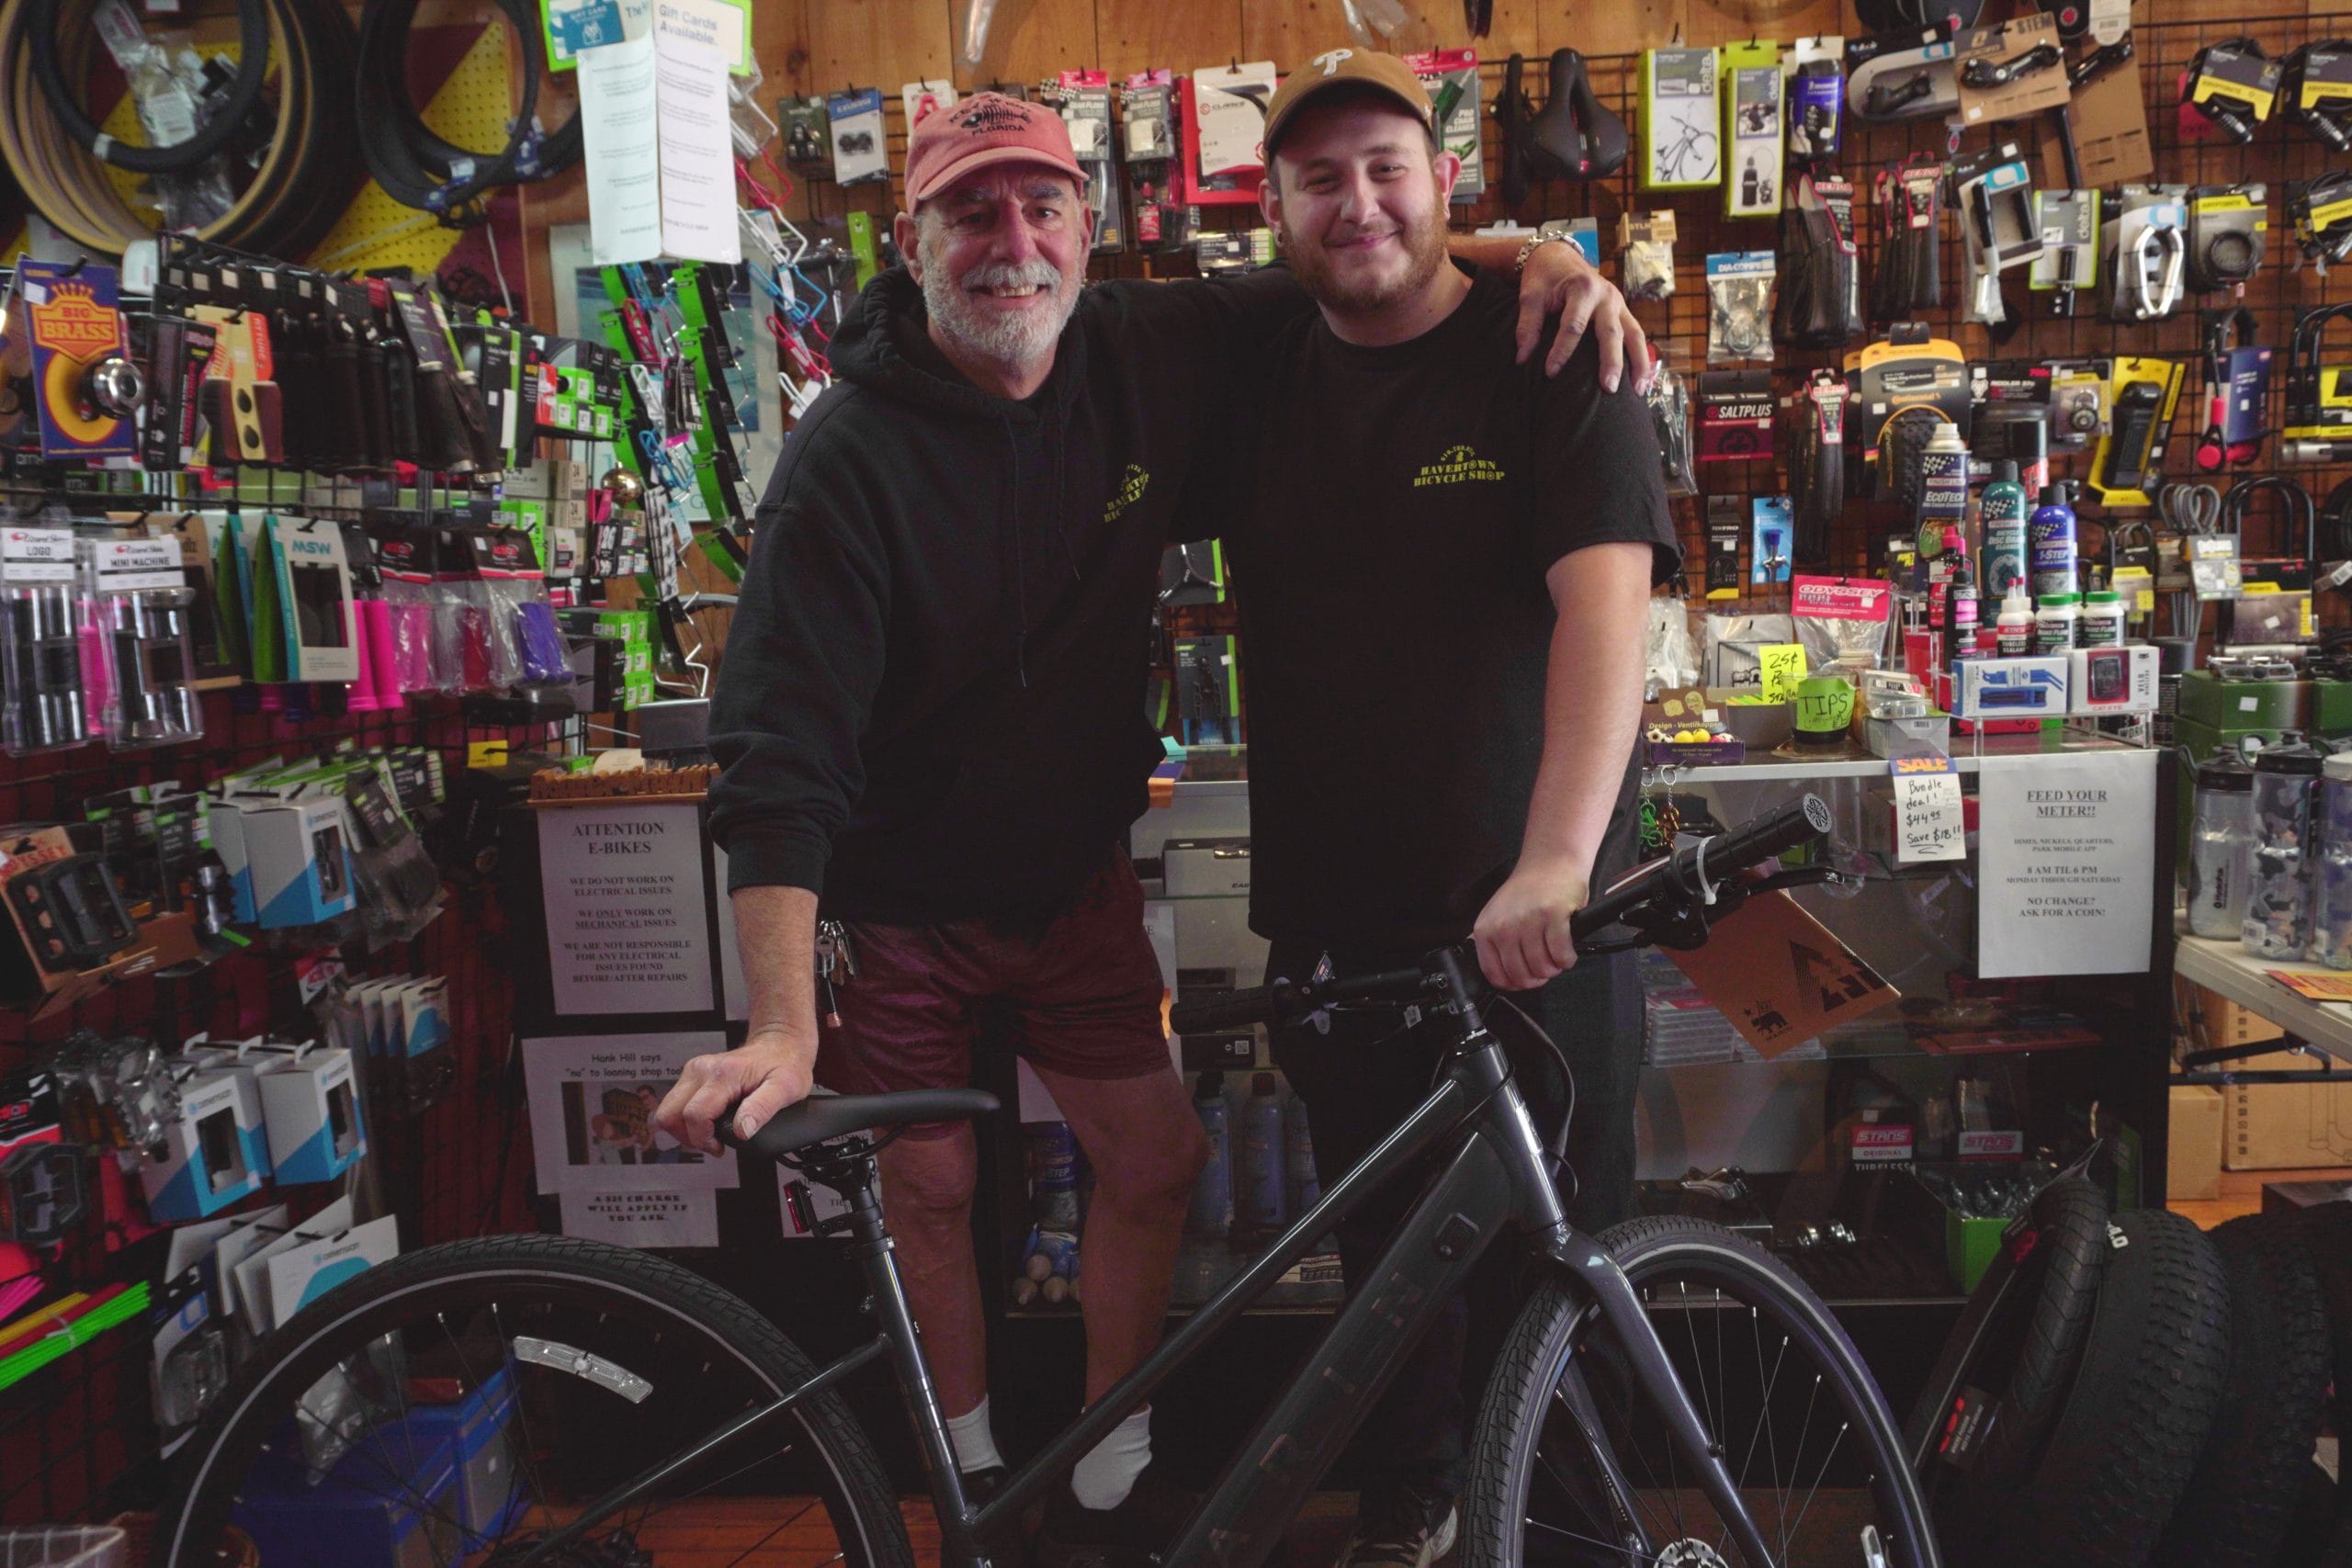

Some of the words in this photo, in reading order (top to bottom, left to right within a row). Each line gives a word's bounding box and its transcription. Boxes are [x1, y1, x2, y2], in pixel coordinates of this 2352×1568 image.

[659, 4, 677, 19] Gift
[682, 12, 718, 30] Cards
[2017, 12, 2053, 35] STEM
[1313, 48, 1352, 75] P
[1458, 108, 1475, 118] PRO
[1453, 117, 1475, 125] CHAIN
[972, 124, 1025, 136] FLORIDA
[1445, 123, 1476, 133] CLEANER
[1815, 182, 1853, 191] KENDA
[62, 307, 90, 319] BIG
[42, 321, 114, 340] BRASS
[1718, 404, 1773, 419] SALTPLUS
[1420, 459, 1496, 476] HAVERTOWN
[1413, 472, 1466, 487] BICYCLE
[1468, 470, 1506, 481] SHOP
[1988, 536, 2005, 545] DISC
[27, 547, 51, 556] LOGO
[292, 540, 332, 555] MSW
[2039, 549, 2067, 559] 1-STEP
[110, 558, 130, 567] MINI
[132, 556, 170, 567] MACHINE
[1798, 584, 1885, 597] ODYSSEY
[1769, 653, 1799, 670] 25¢
[1800, 693, 1849, 716] TIPS
[1648, 721, 1672, 730] Design
[1895, 758, 1949, 773] SALE
[1909, 779, 1942, 795] Bundle
[2027, 790, 2064, 802] FEED
[2066, 790, 2108, 802] YOUR
[2036, 805, 2097, 818] METER!!
[573, 822, 665, 837] ATTENTION
[1907, 832, 1929, 844] Save
[588, 841, 651, 854] E-BIKES
[2027, 866, 2032, 874] 8
[2033, 866, 2052, 874] AM
[2054, 866, 2072, 874] TIL
[587, 876, 603, 885] DO
[605, 876, 625, 885] NOT
[627, 875, 657, 884] WORK
[660, 874, 674, 883] ON
[574, 887, 636, 897] ELECTRICAL
[2027, 897, 2043, 906] NO
[2045, 897, 2096, 906] CHANGE?
[578, 909, 594, 918] WE
[596, 908, 622, 919] ONLY
[625, 908, 655, 917] WORK
[657, 908, 672, 916] ON
[2018, 909, 2040, 918] ASK
[2042, 908, 2065, 917] FOR
[2066, 908, 2074, 917] A
[2075, 908, 2106, 917] COIN!
[575, 919, 641, 930] MECHANICAL
[643, 919, 676, 927] ISSUES
[564, 942, 581, 950] WE
[582, 942, 602, 950] ARE
[604, 942, 623, 950] NOT
[626, 940, 692, 949] RESPONSIBLE
[597, 953, 617, 961] ANY
[619, 952, 681, 960] ELECTRICAL
[630, 963, 663, 971] FOUND
[647, 973, 688, 982] REPAIRS
[591, 1054, 616, 1062] Hank
[620, 1053, 637, 1061] Hill
[640, 1054, 662, 1064] says
[566, 1067, 585, 1077] "no"
[590, 1067, 600, 1077] to
[604, 1067, 638, 1078] loaning
[641, 1066, 662, 1077] shop
[1856, 1130, 1908, 1143] STANS
[1863, 1149, 1902, 1157] ORIGINAL
[626, 1194, 681, 1202] CHARGE
[587, 1204, 623, 1213] WILL
[608, 1214, 634, 1223] YOU
[639, 1213, 668, 1222] ASK.
